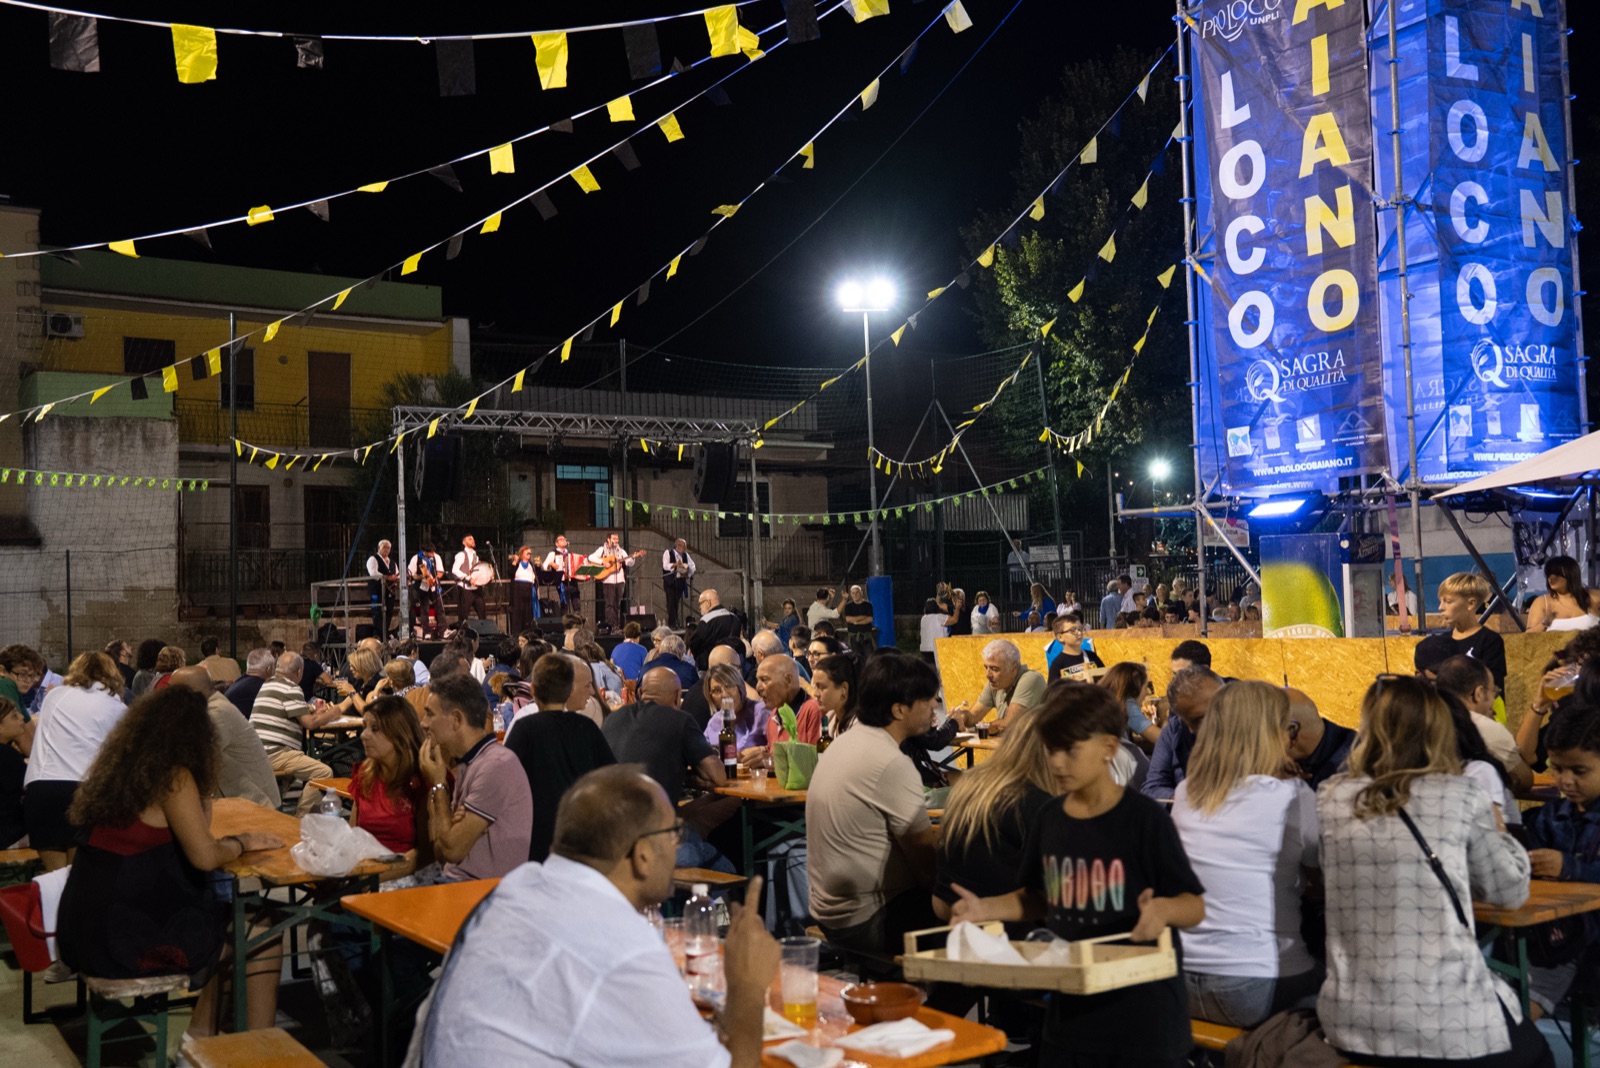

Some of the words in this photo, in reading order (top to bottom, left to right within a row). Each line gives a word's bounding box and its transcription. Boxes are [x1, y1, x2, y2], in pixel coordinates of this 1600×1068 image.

[1249, 10, 1279, 25] UNPLI
[1445, 15, 1497, 325] LOCO
[1219, 70, 1275, 349] LOCO
[1280, 349, 1346, 378] SAGRA
[1505, 344, 1557, 365] SAGRA
[1283, 380, 1295, 392] DI
[1296, 368, 1347, 392] QUALITÀ
[1506, 365, 1518, 378] DI
[1253, 457, 1353, 477] WWW.PROLOCOBAIANO.IT
